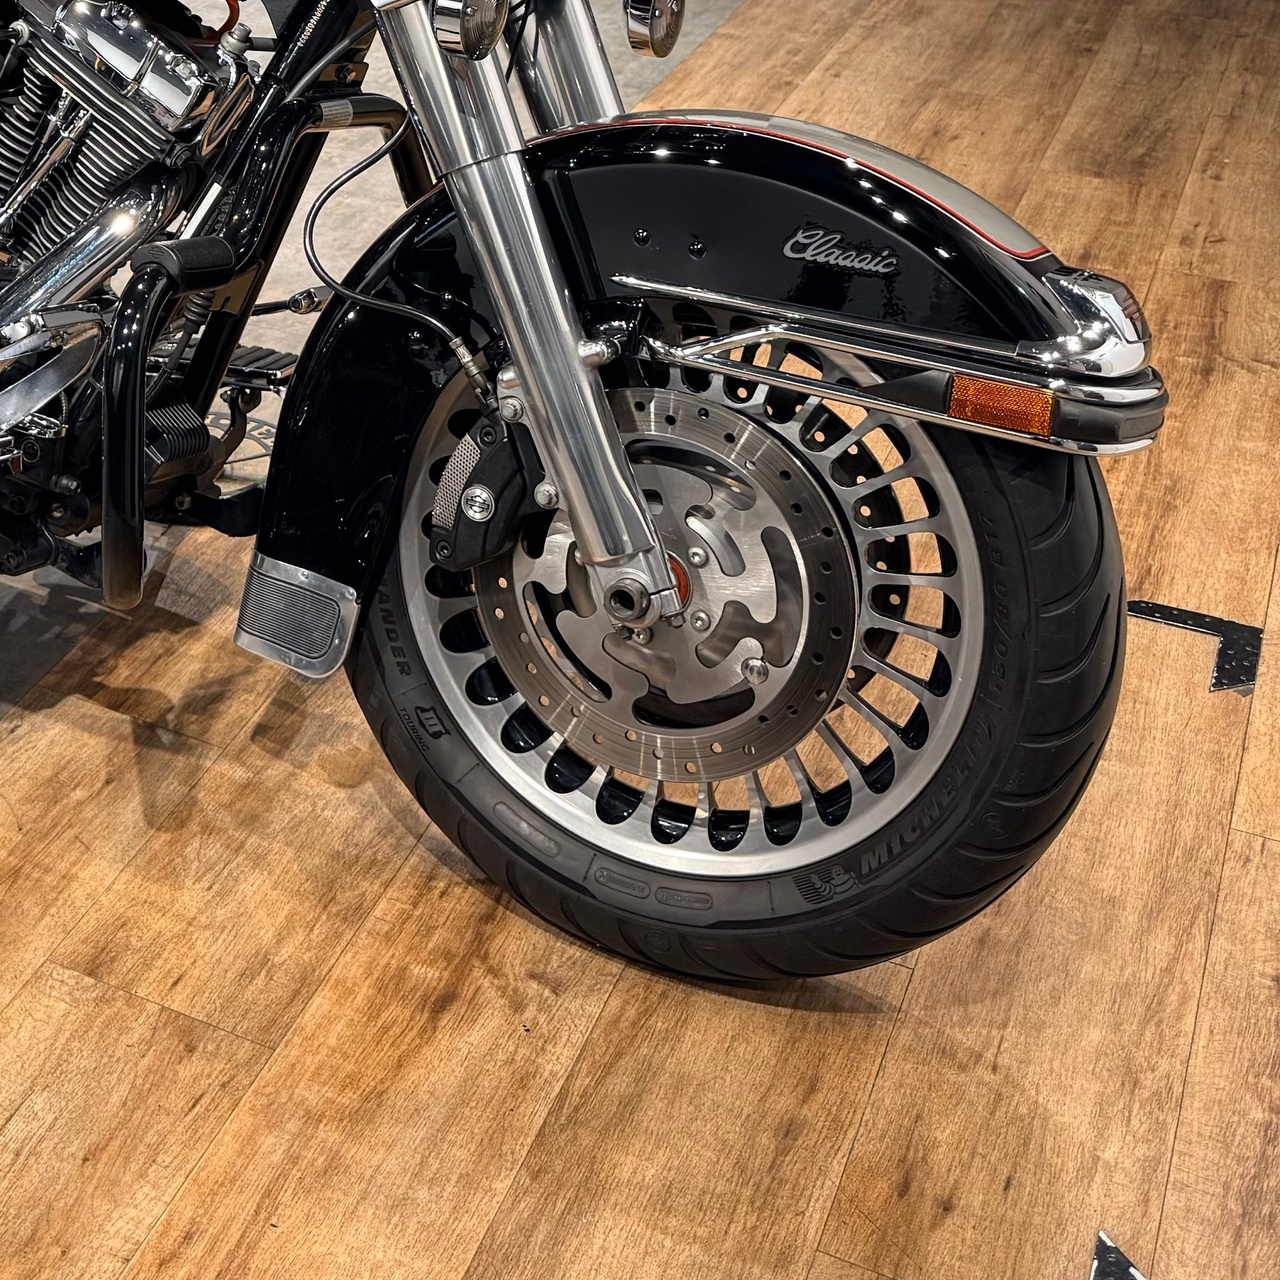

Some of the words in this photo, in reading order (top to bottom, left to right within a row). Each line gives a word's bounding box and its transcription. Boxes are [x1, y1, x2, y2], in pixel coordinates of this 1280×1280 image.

[783, 229, 897, 272] Classic
[399, 707, 431, 753] TOURING
[858, 716, 994, 875] MICHELIN
